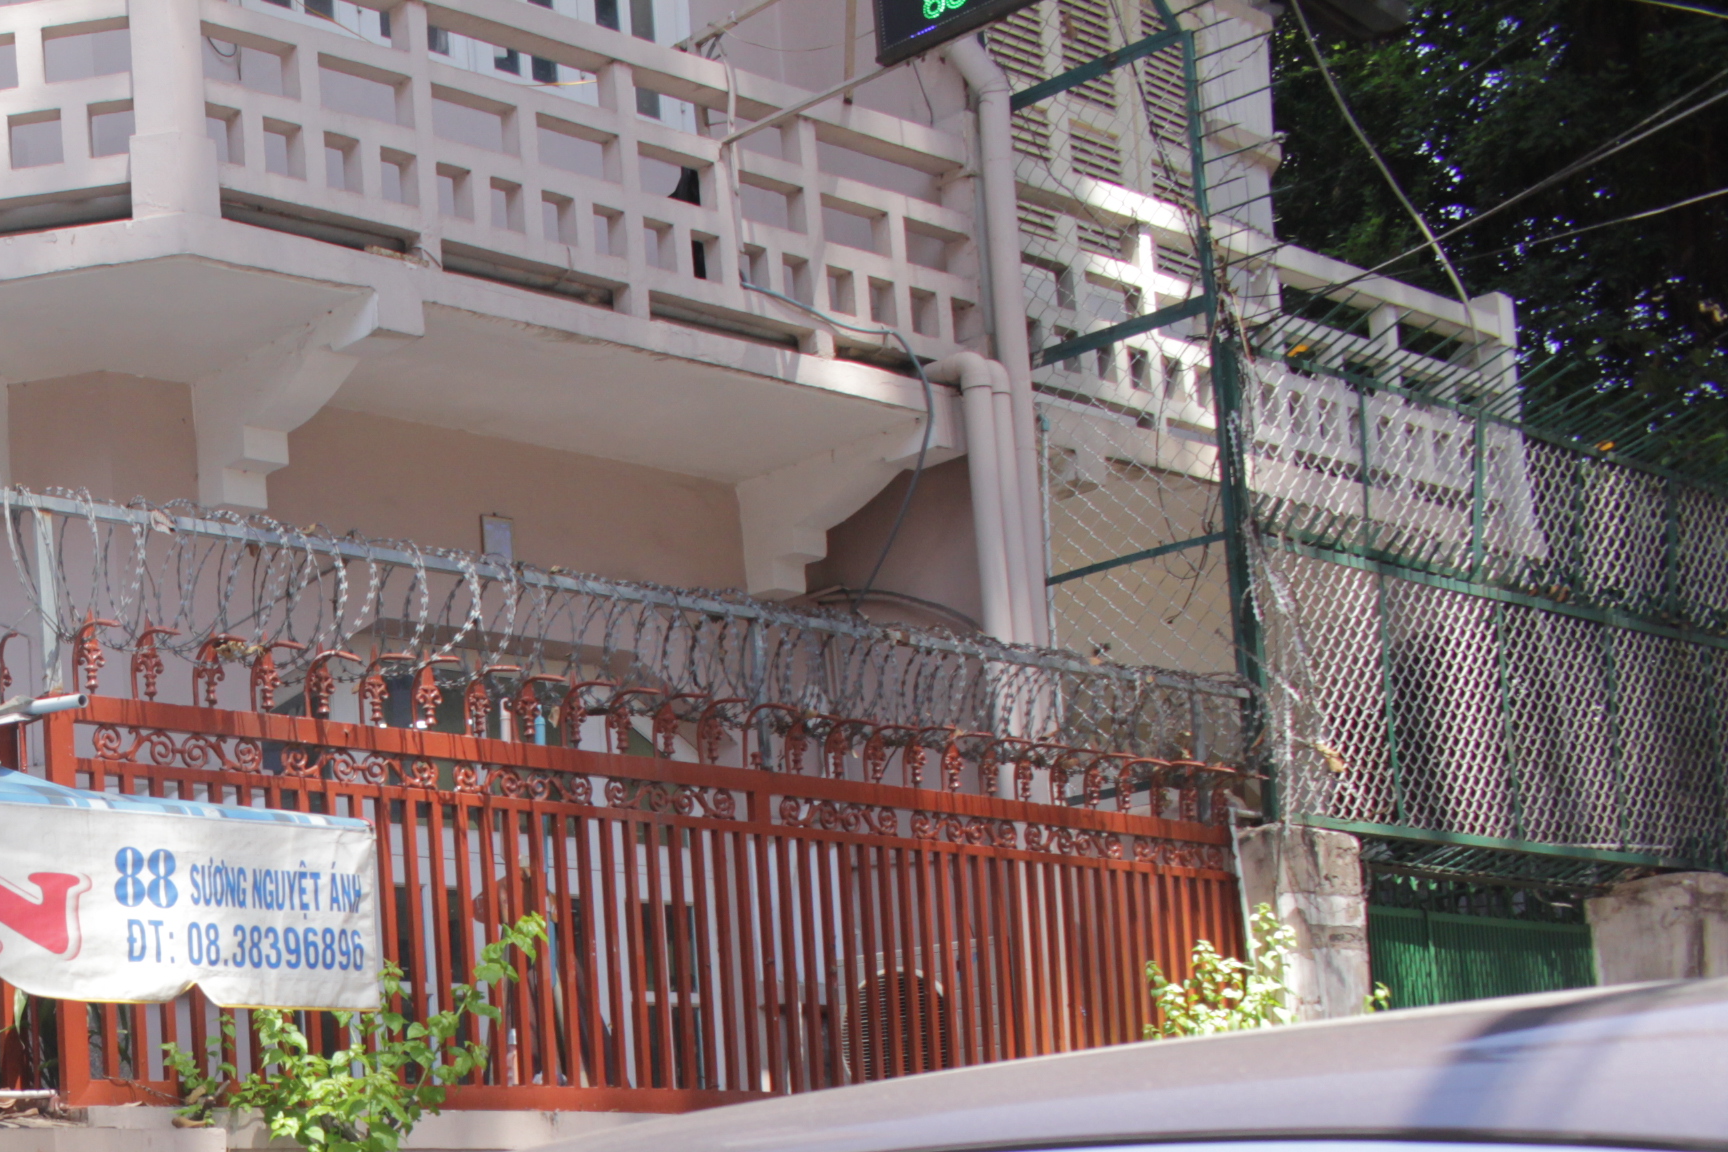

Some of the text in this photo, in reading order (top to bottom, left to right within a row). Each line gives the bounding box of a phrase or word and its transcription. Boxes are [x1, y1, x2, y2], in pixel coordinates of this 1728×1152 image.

[114, 846, 362, 920] 88 SƯƠNG NGUYỆT ÁNH
[127, 919, 365, 971] ĐT: 08.38396896
